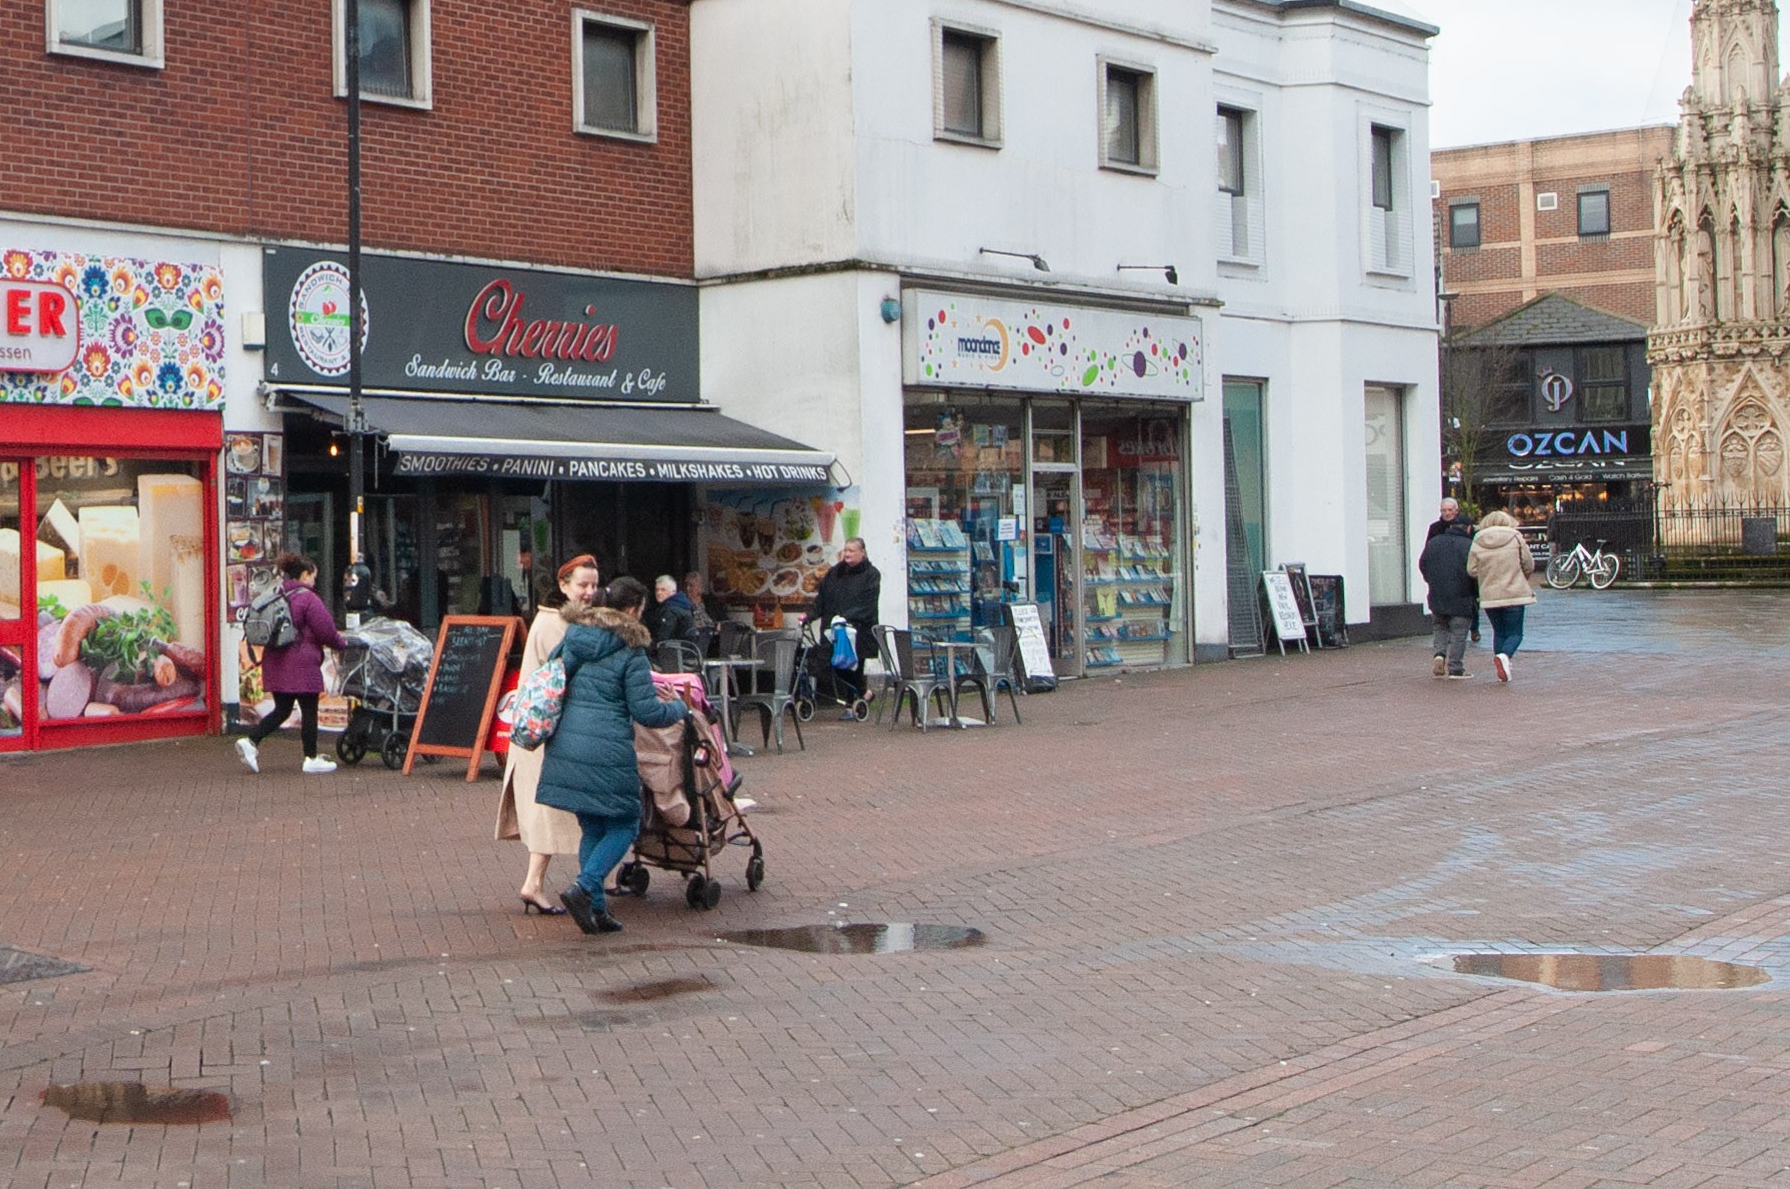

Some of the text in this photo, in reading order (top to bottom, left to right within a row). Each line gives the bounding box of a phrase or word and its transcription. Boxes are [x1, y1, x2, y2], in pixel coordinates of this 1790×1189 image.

[298, 273, 343, 309] SANDWICH
[464, 278, 619, 361] Cherries
[270, 362, 279, 377] 4
[405, 353, 477, 380] Sandwich
[481, 359, 516, 383] Bar
[534, 363, 617, 388] Restaurant
[621, 373, 634, 394] &
[637, 369, 666, 395] Cafe
[1507, 430, 1628, 456] OZCAN
[400, 455, 827, 480] SMOOTHIES PANINI PANCAKES MILKSHAKES HOT DRINKS
